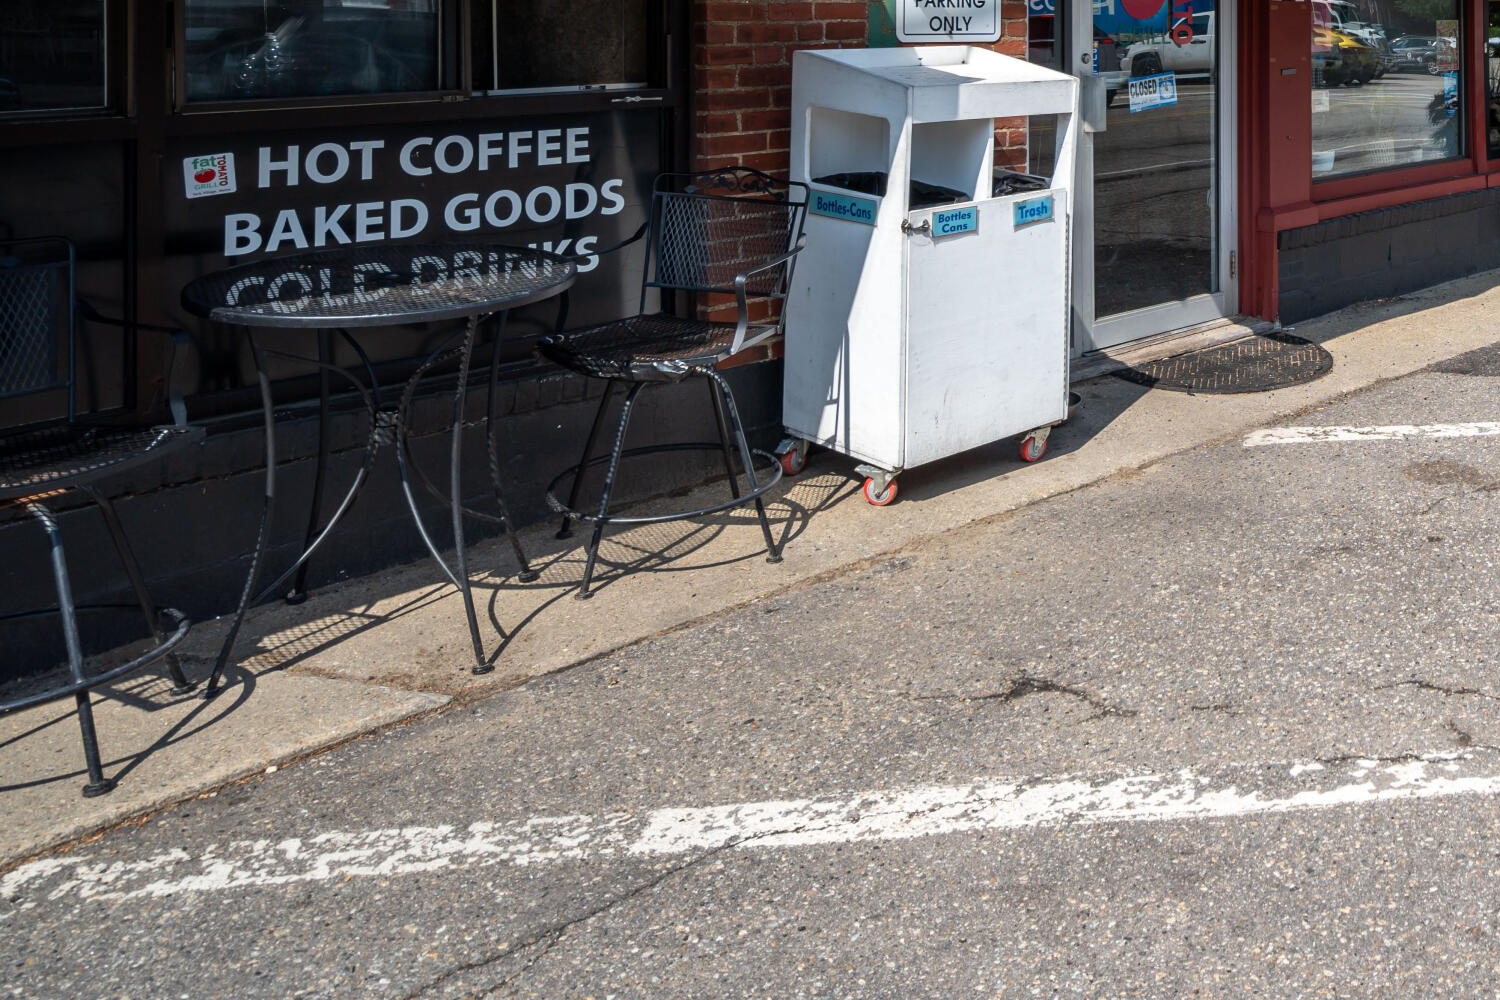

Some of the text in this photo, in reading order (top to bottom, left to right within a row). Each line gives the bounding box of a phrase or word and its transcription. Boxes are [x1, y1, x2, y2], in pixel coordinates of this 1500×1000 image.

[929, 16, 972, 31] ONLY
[1118, 25, 1171, 46] GRILL
[1130, 80, 1157, 98] CLOSED
[192, 156, 217, 170] fat
[257, 127, 591, 189] HOT COFFEE
[816, 196, 872, 220] Bottles-Cans
[1018, 201, 1048, 219] Trash
[224, 178, 625, 257] BAKED GOODS
[938, 211, 972, 224] Bottles
[941, 222, 968, 233] Cans
